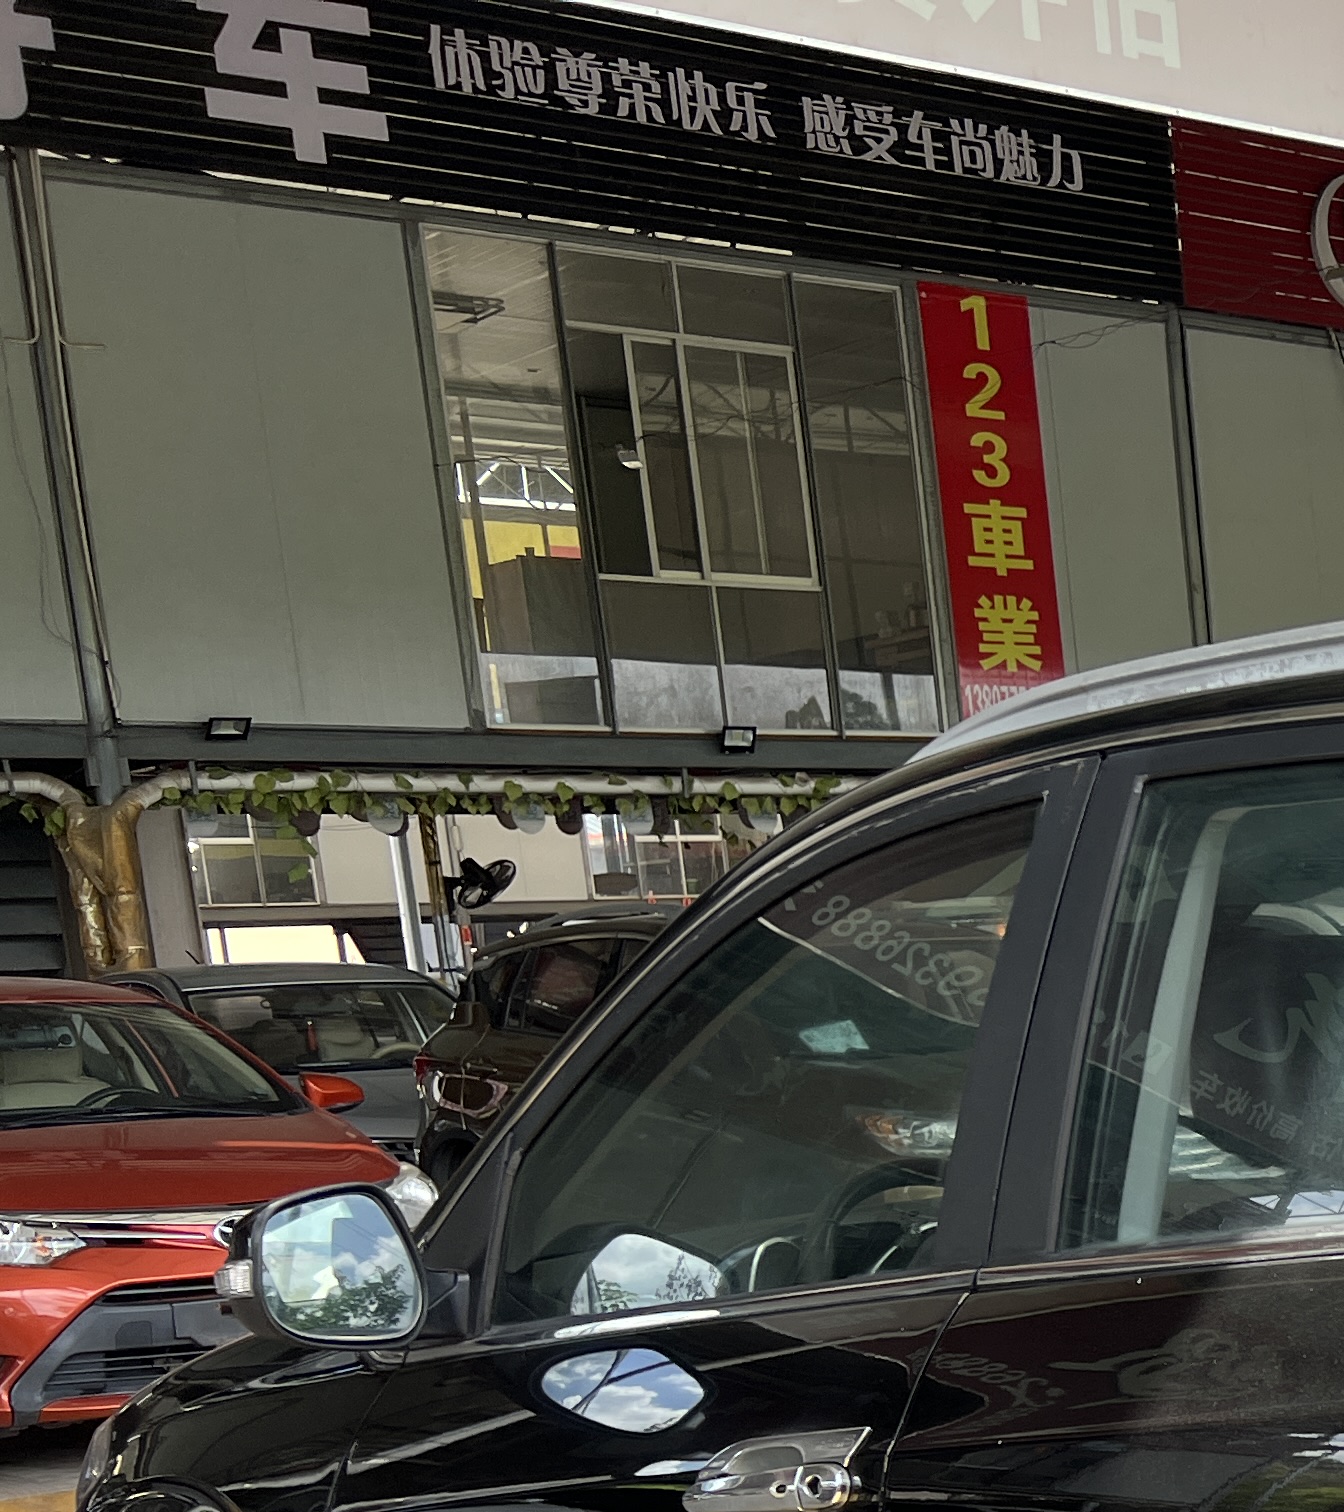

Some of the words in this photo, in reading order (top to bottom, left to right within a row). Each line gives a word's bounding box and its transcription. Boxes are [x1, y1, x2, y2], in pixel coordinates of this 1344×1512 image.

[429, 24, 777, 143] 体验尊荣快乐
[800, 93, 1084, 192] 感受车尚魅力
